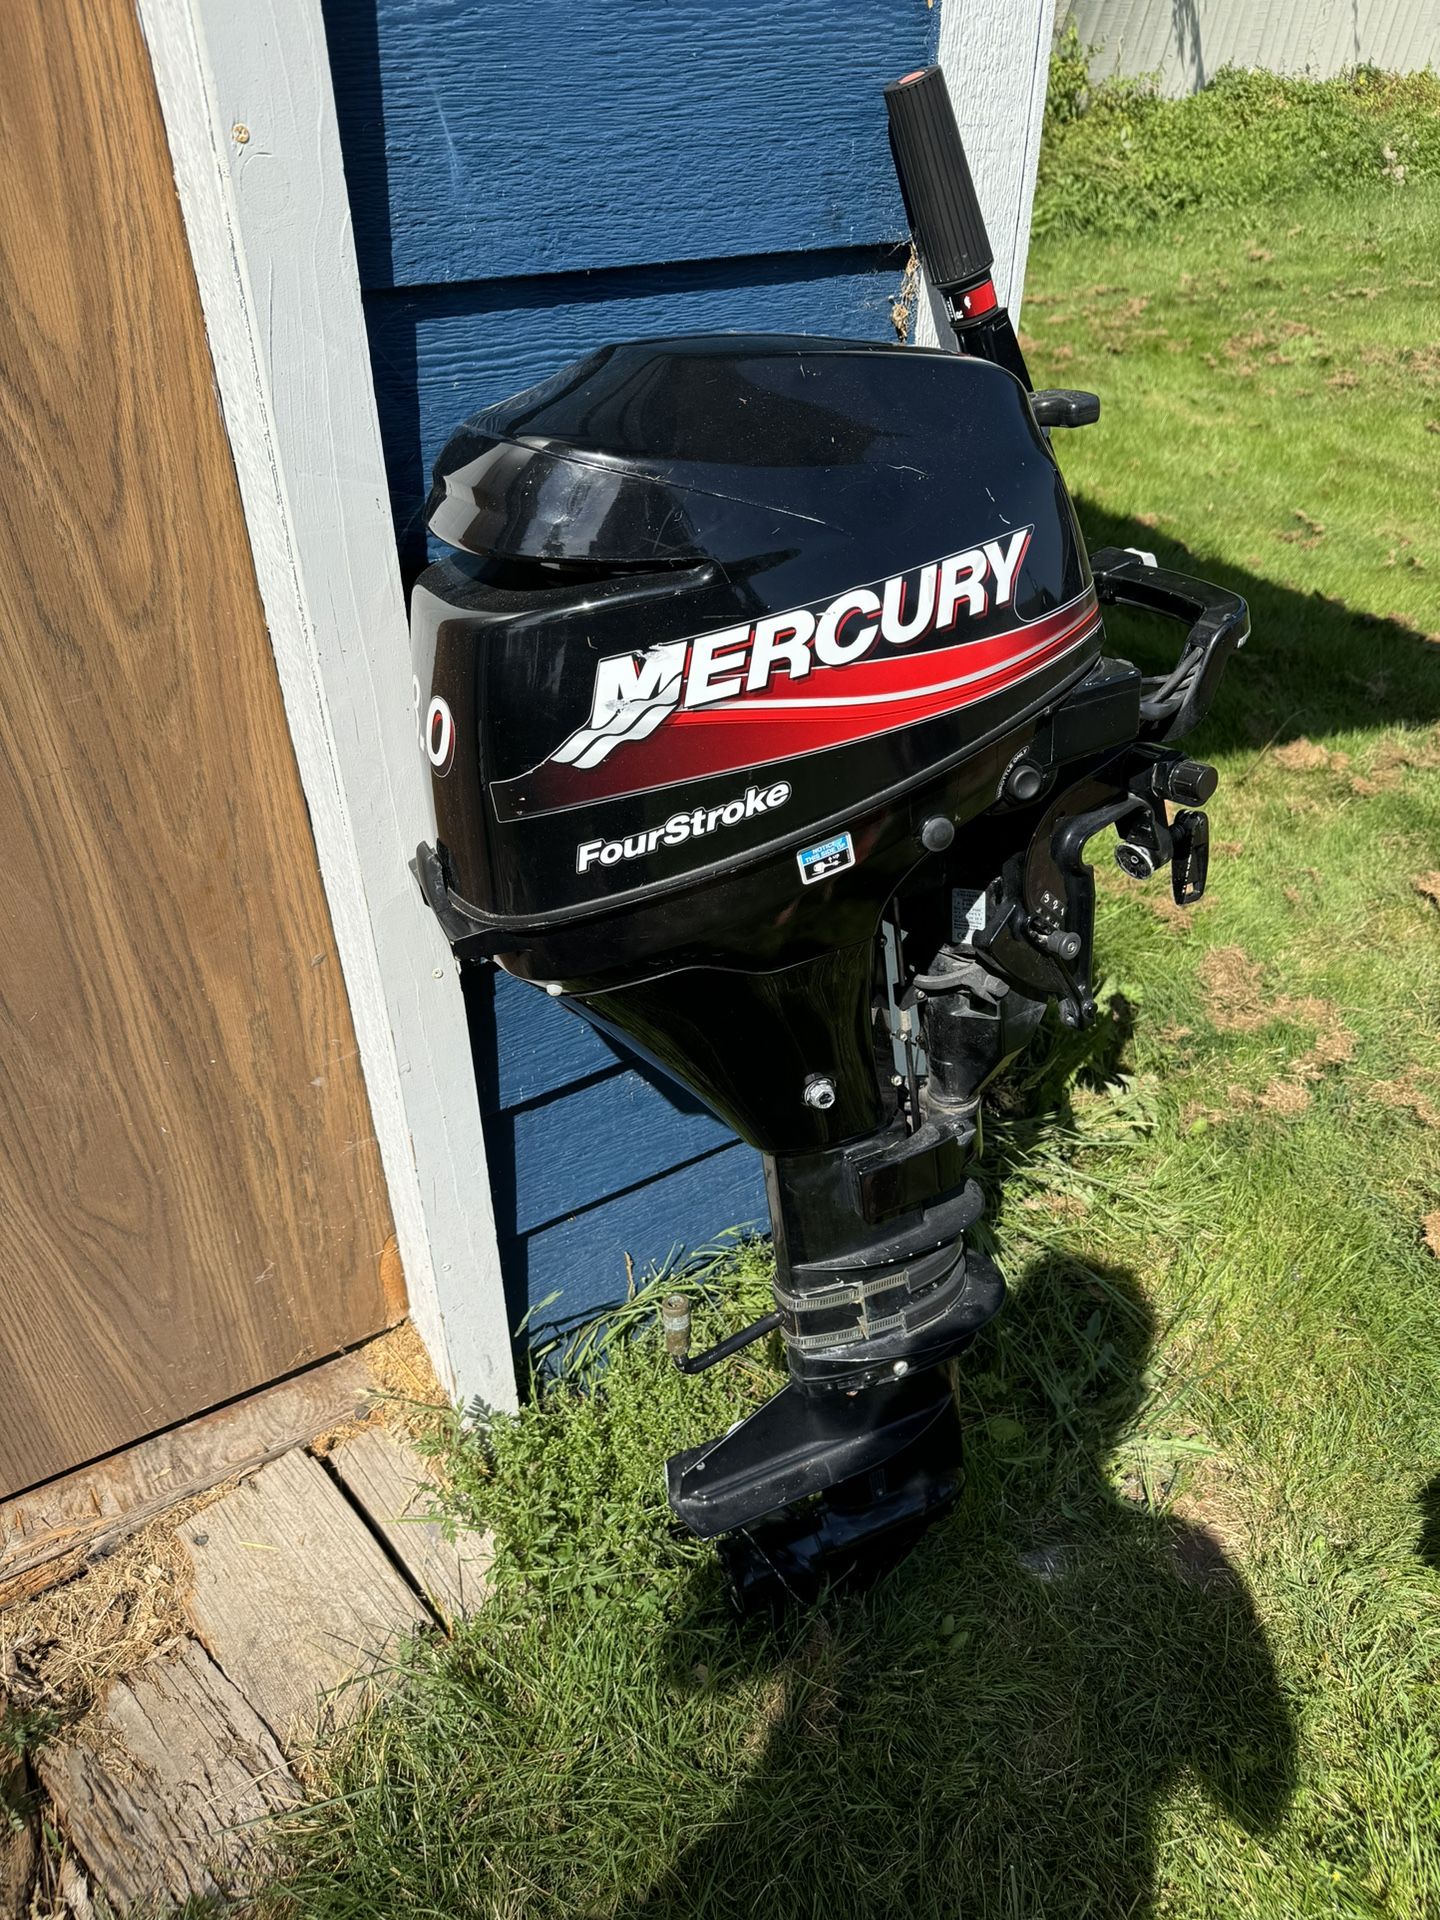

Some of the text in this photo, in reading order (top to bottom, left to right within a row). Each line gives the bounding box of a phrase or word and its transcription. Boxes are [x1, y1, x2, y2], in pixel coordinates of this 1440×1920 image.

[590, 529, 1030, 729] MERCURY
[577, 782, 791, 873] FourStroke
[1052, 899, 1059, 910] 2
[1060, 907, 1065, 916] 1
